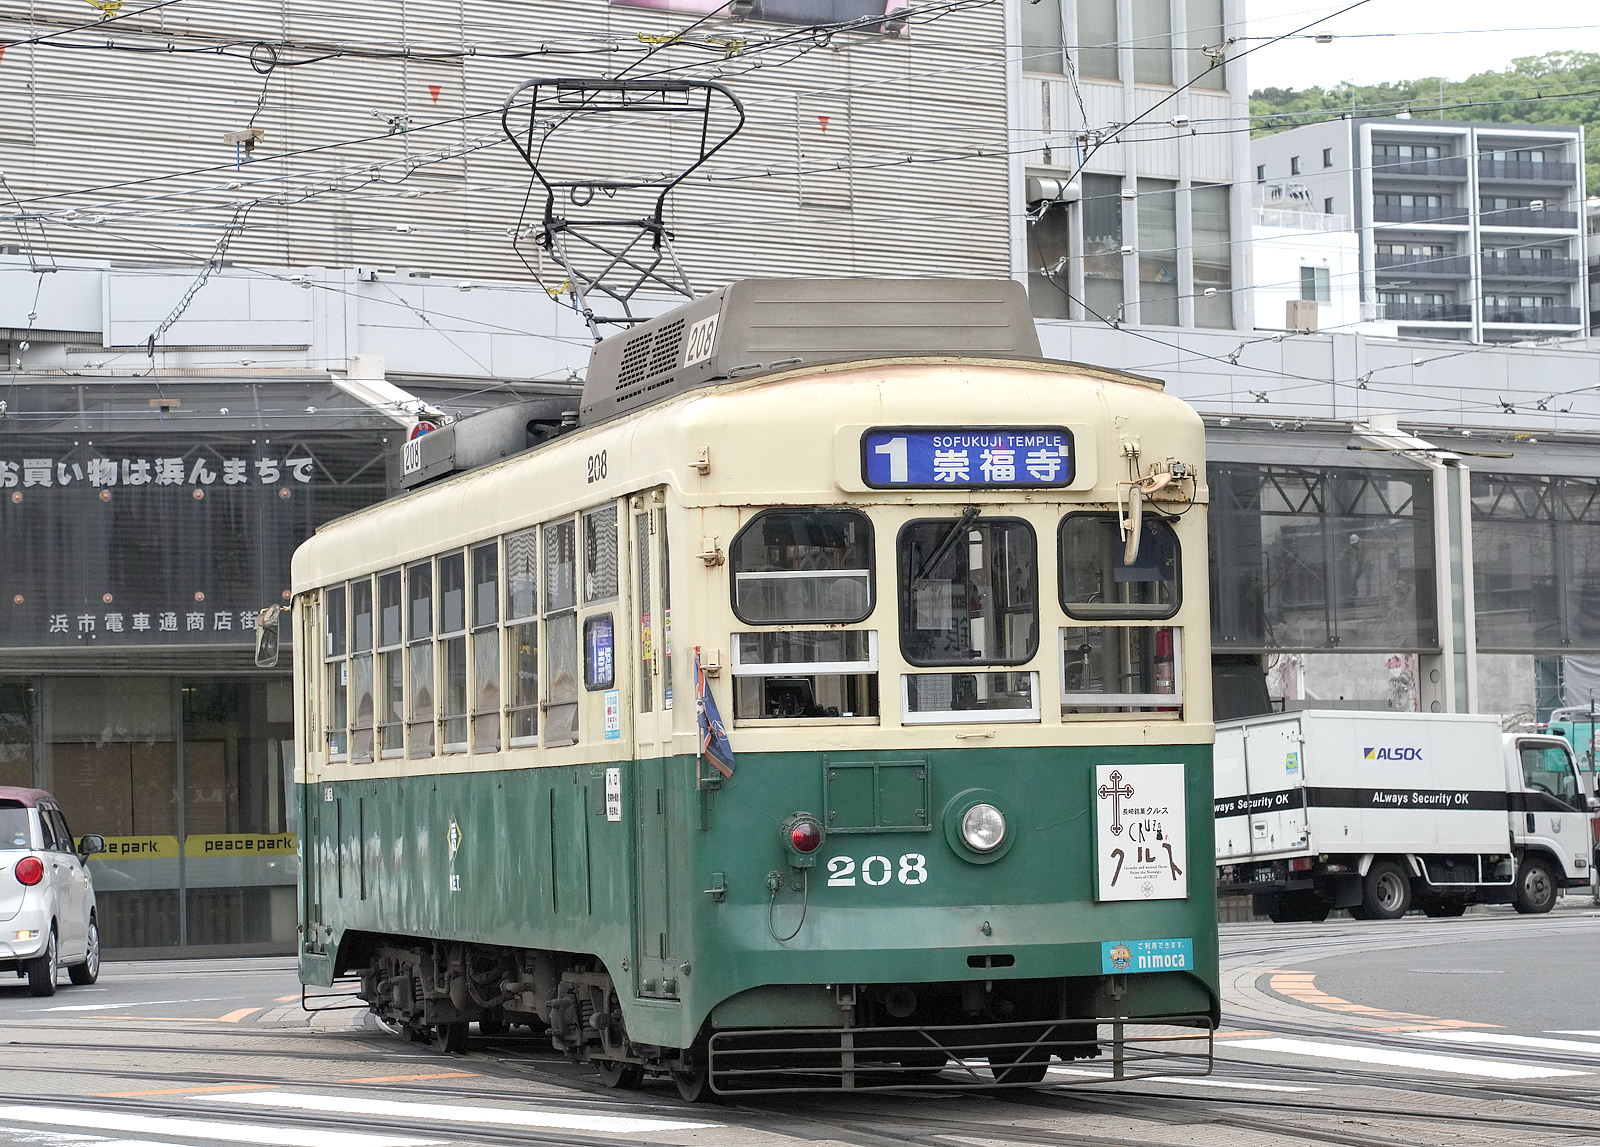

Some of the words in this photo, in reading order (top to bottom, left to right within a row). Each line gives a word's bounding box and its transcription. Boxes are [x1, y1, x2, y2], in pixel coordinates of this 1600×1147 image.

[687, 320, 714, 361] 208
[933, 436, 1002, 447] SOFUKUJI
[1007, 436, 1061, 447] TEMPLE
[405, 441, 419, 470] 208
[587, 449, 607, 483] 208
[874, 437, 908, 482] 1
[933, 449, 1061, 482] 崇福寺
[0, 457, 313, 488] お買い物は浜んまちで
[49, 611, 258, 633] 浜市電車通商店街
[1376, 748, 1423, 760] ALSOK
[1237, 797, 1273, 809] Security
[1275, 793, 1289, 805] OK
[1372, 791, 1408, 806] ALways
[1412, 792, 1452, 806] Security
[1454, 793, 1469, 804] OK
[205, 840, 253, 852] peace
[827, 853, 928, 887] 208
[1138, 950, 1185, 968] nimoca
